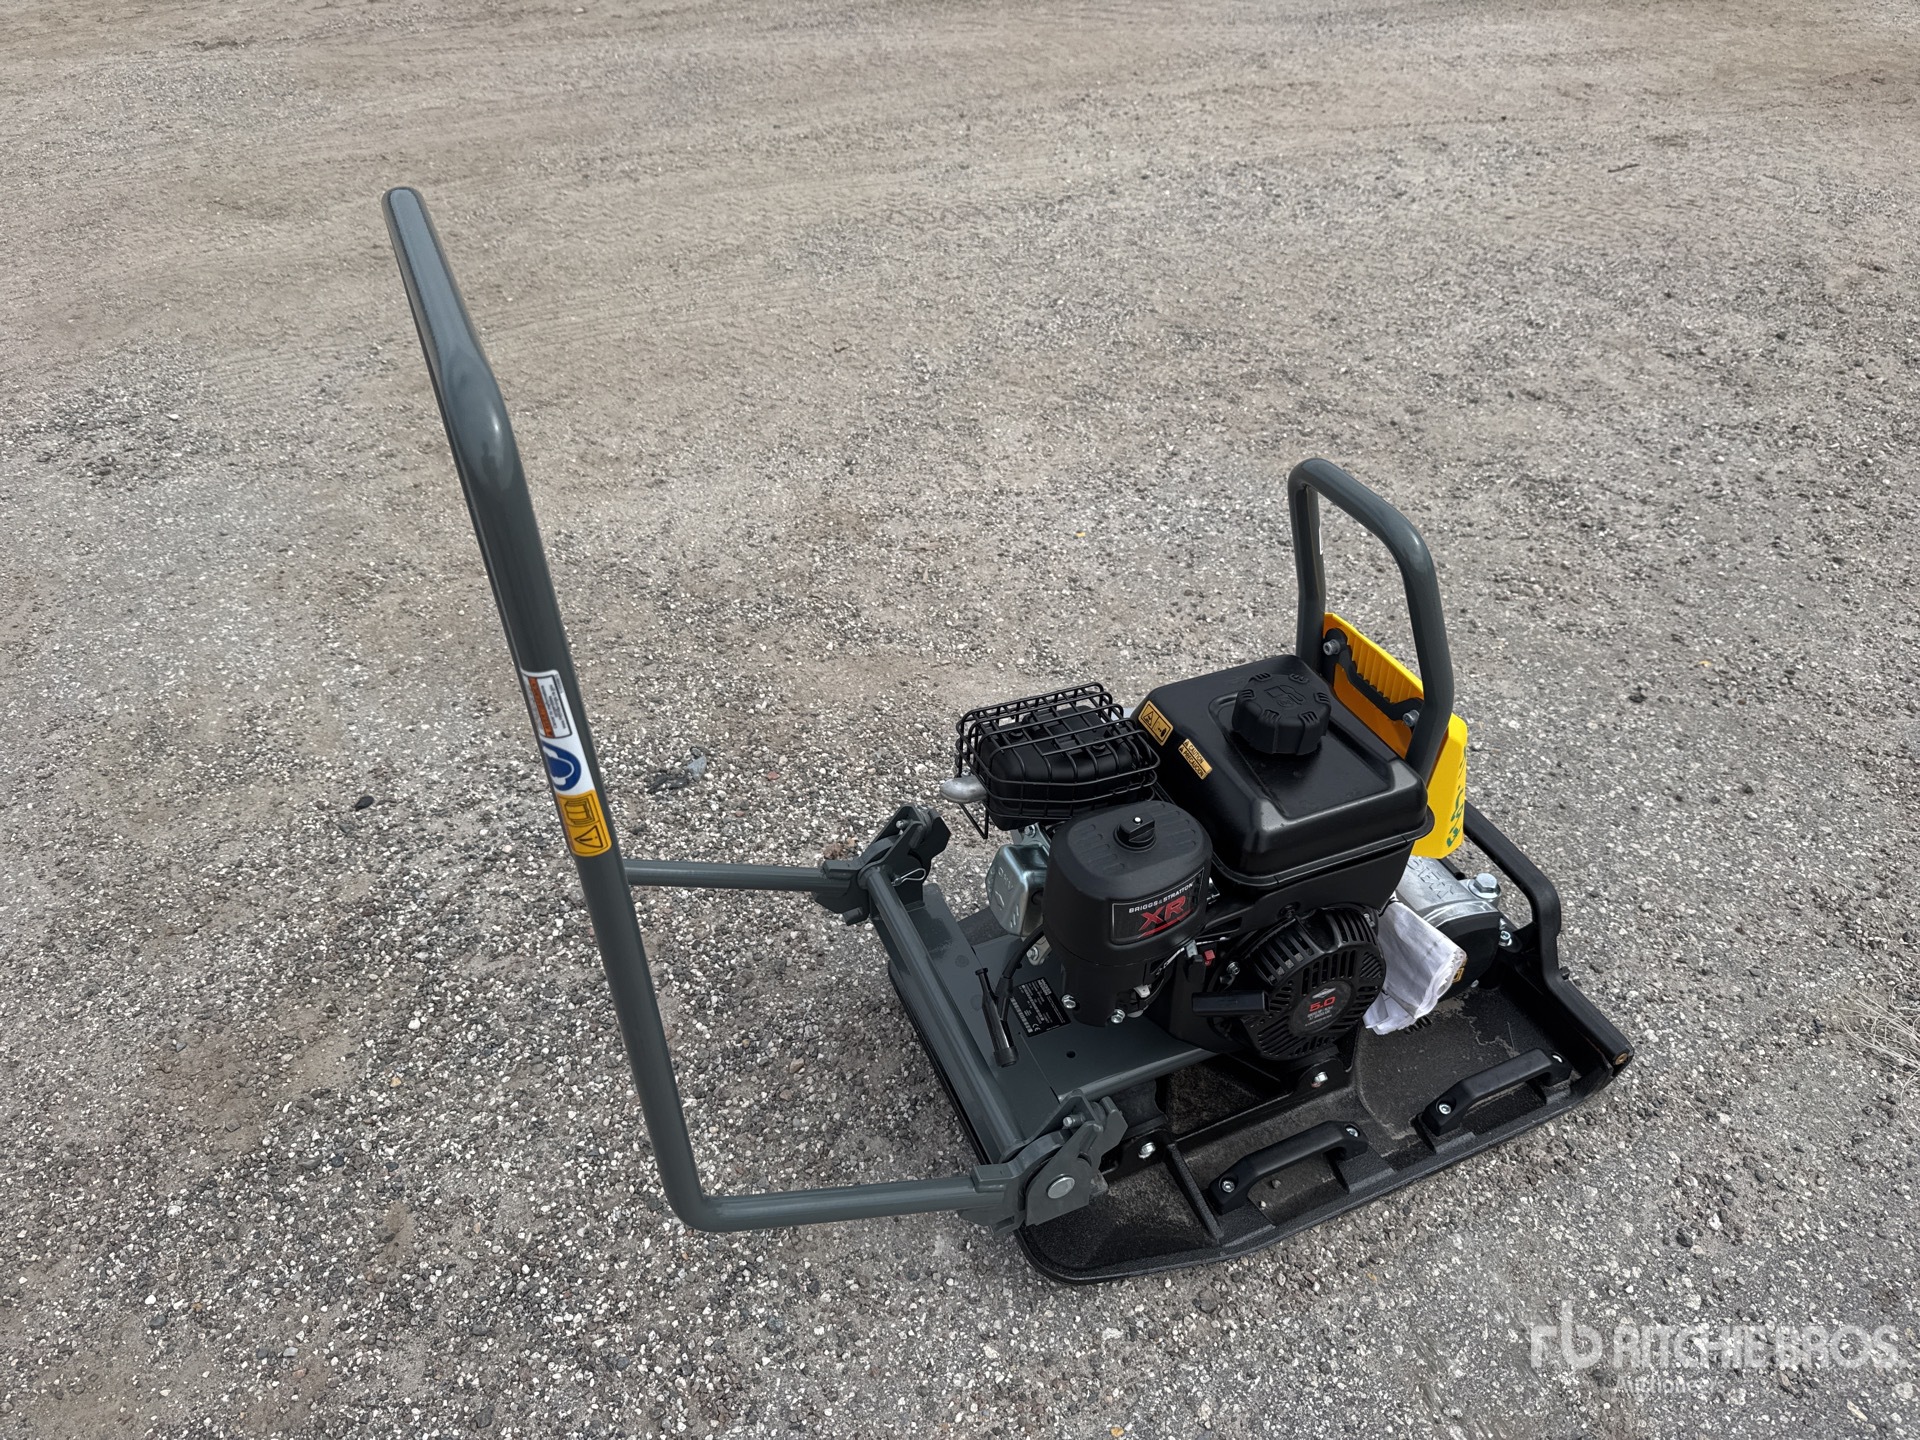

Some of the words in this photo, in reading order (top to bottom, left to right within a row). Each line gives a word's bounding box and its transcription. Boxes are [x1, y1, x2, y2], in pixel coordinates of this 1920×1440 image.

[1128, 899, 1159, 914] BRIGGS
[1162, 882, 1194, 903] STRATTON
[1138, 895, 1187, 931] XR
